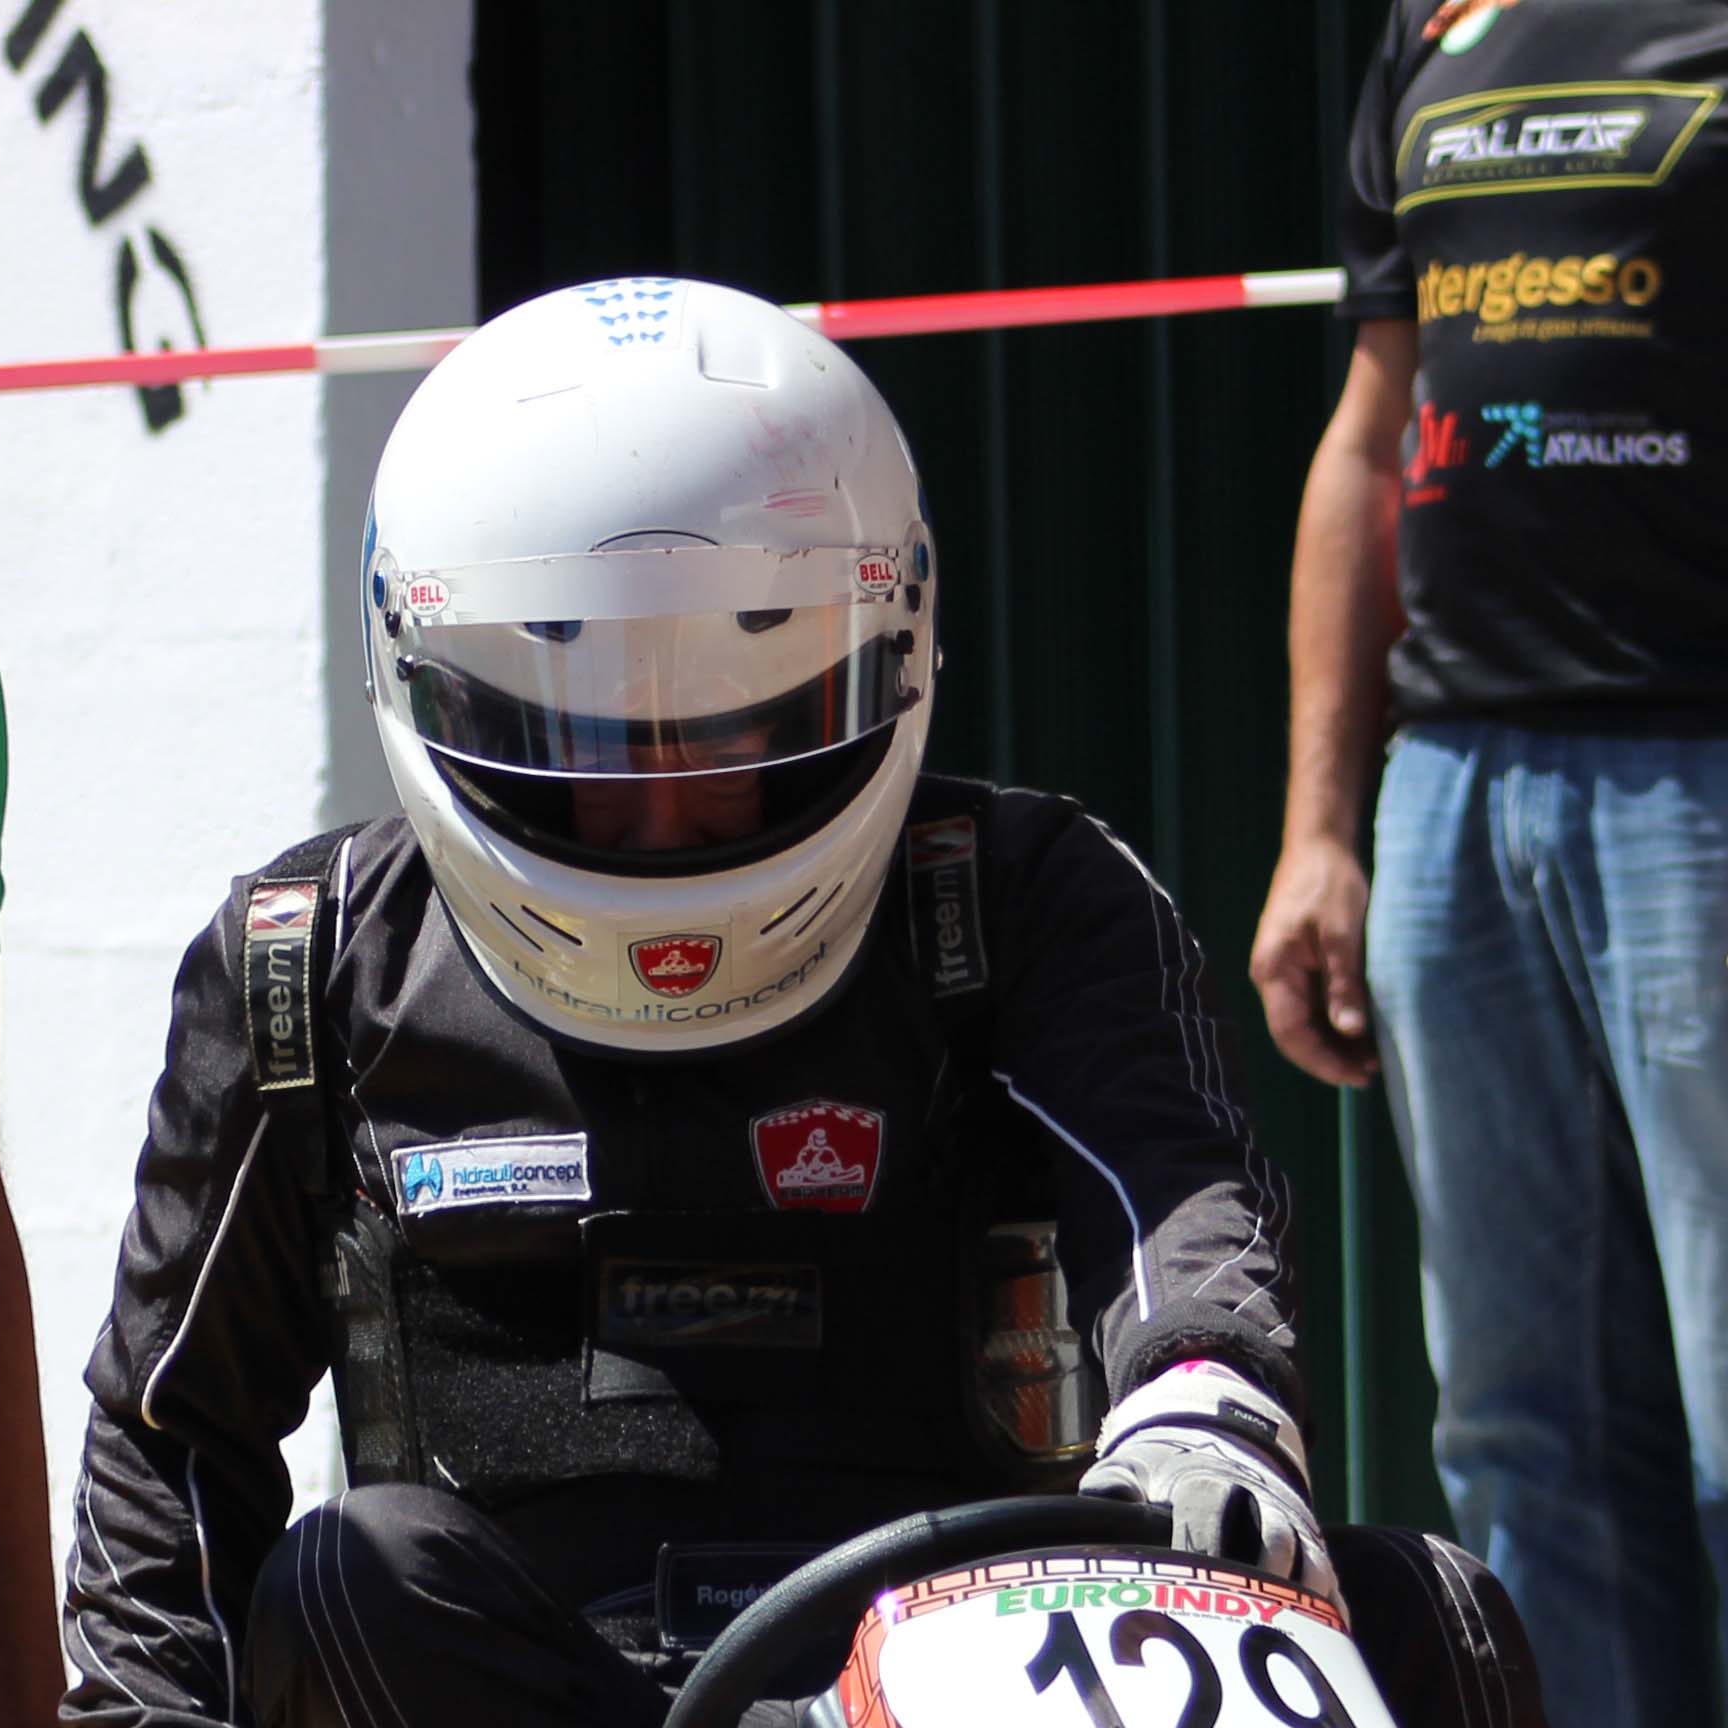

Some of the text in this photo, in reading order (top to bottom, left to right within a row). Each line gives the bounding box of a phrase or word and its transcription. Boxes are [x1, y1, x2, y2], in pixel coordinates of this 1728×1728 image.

[1543, 433, 1690, 466] ATALHOS
[859, 562, 894, 582] BELL
[411, 585, 444, 604] BELL
[935, 868, 969, 985] freem
[267, 943, 297, 1075] freem
[452, 1161, 583, 1185] hidrauliconcept
[995, 1582, 1282, 1624] EUROINDY
